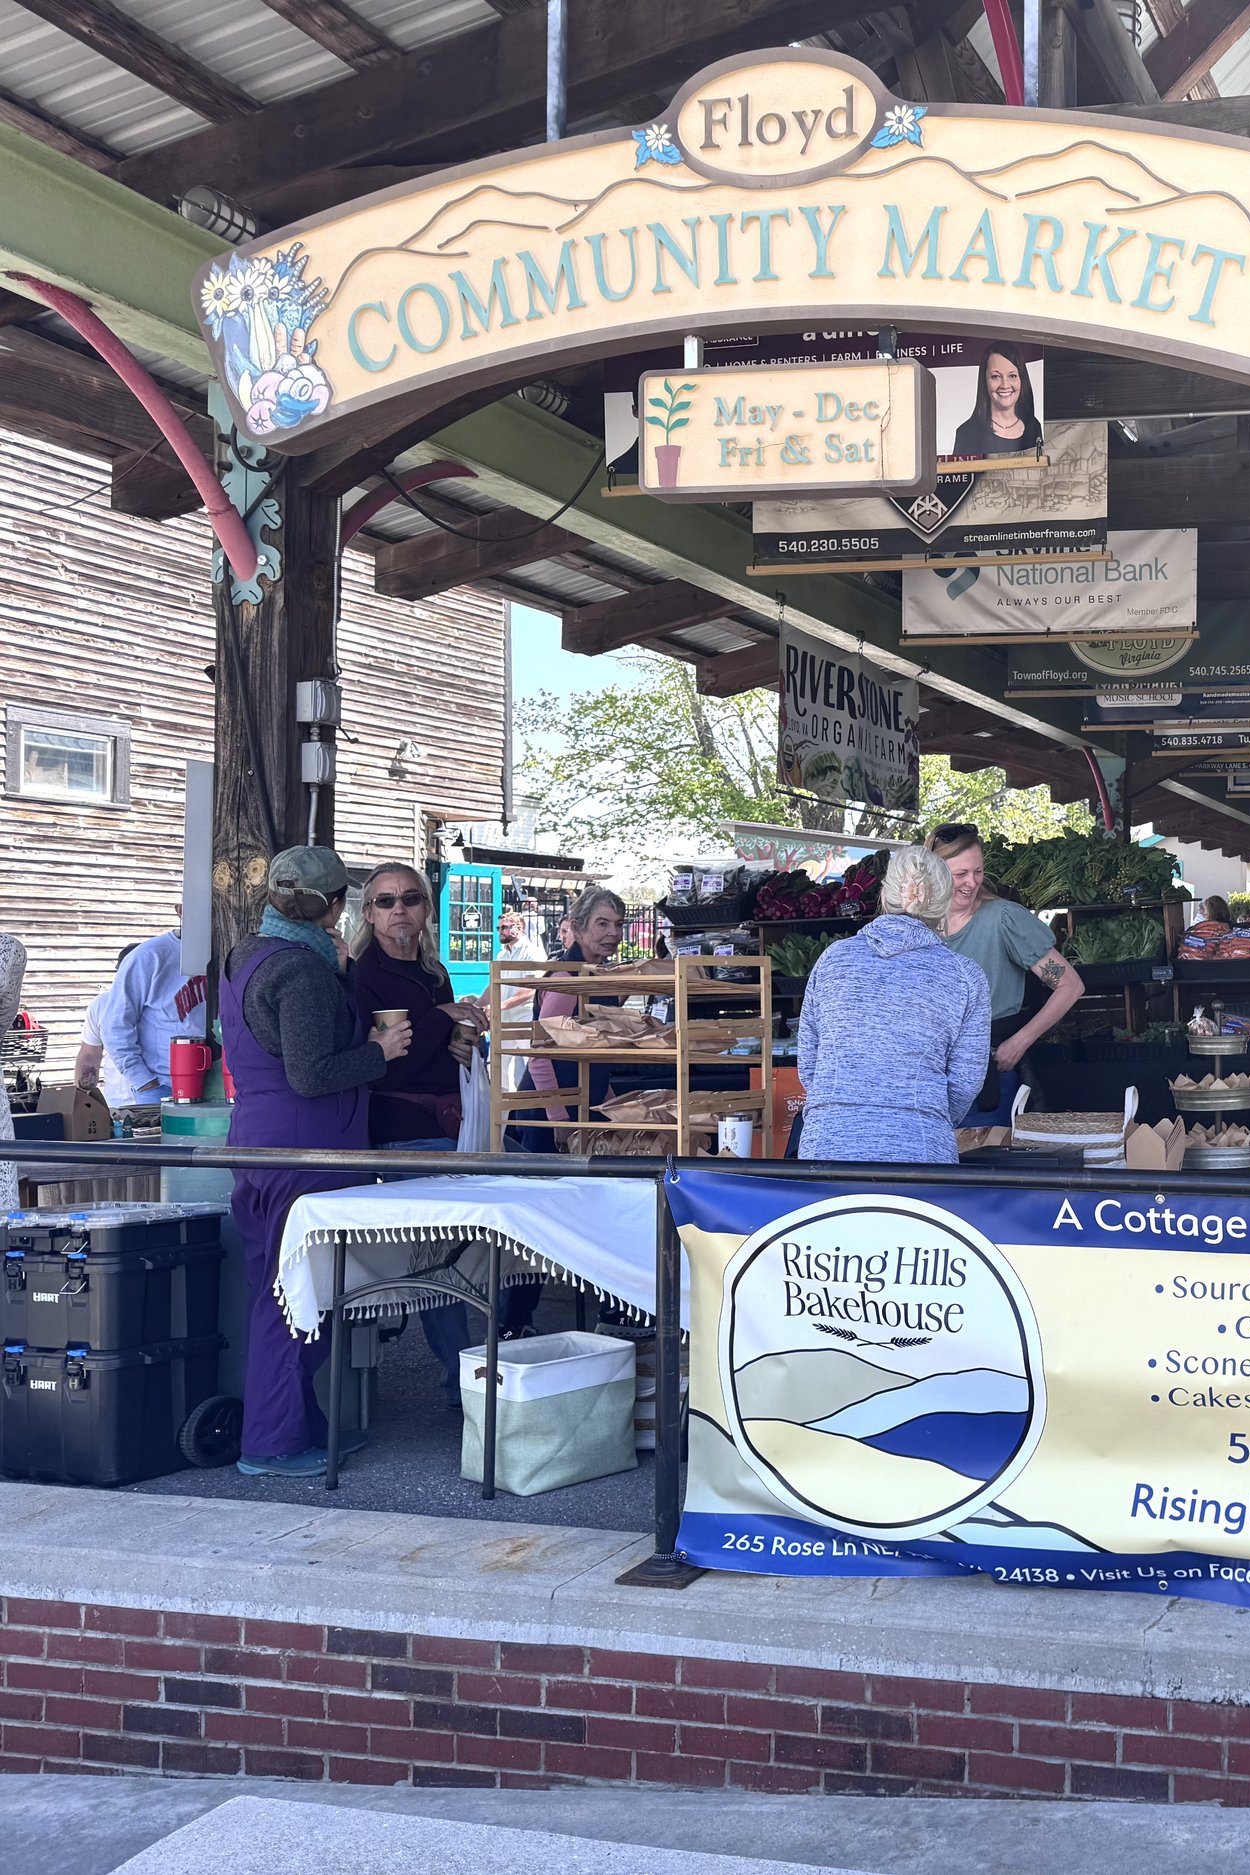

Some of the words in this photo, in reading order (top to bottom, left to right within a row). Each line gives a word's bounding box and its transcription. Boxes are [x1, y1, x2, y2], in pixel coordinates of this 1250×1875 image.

[698, 84, 859, 154] Floyd
[347, 205, 846, 373] COMMUNITY
[877, 204, 1247, 328] MARKET
[941, 343, 963, 354] LIFE
[713, 396, 783, 432] May
[815, 391, 880, 423] Dec
[718, 437, 764, 468] Fri
[779, 434, 811, 465] &
[824, 433, 876, 464] Sat
[937, 474, 969, 484] RAME
[778, 537, 879, 553] 540.230.5505
[963, 528, 1096, 543] streamlinetimberframe.com
[997, 562, 1095, 586] National
[1105, 556, 1168, 583] Bank
[997, 597, 1048, 607] ALWAYS
[1054, 595, 1081, 605] OUR
[1089, 594, 1122, 604] BEST
[1127, 607, 1158, 616] Member
[1159, 605, 1179, 615] FDIC
[1107, 638, 1176, 651] FLOYD
[1119, 651, 1161, 667] Virginia
[1012, 669, 1088, 682] TownofFloyd.org
[786, 644, 905, 734] RIVERSTONE
[1104, 694, 1133, 702] MUSIC
[1136, 693, 1175, 702] SCHOOL
[811, 714, 871, 755] ORGANIC
[875, 735, 906, 765] FARM
[1161, 736, 1223, 746] 540.835.4718
[1052, 1199, 1082, 1230] A
[1094, 1199, 1247, 1244] Cottage
[781, 1241, 889, 1293] Rising
[895, 1246, 967, 1288] Hills
[33, 1292, 60, 1304] HART
[783, 1280, 965, 1334] Bakehouse
[30, 1380, 57, 1391] HART
[722, 1533, 765, 1553] 265
[771, 1536, 825, 1556] Rose
[832, 1538, 857, 1556] Ln
[994, 1567, 1059, 1582] 24138
[1079, 1567, 1131, 1582] Visit
[1137, 1566, 1167, 1580] Us
[1173, 1566, 1203, 1579] on
